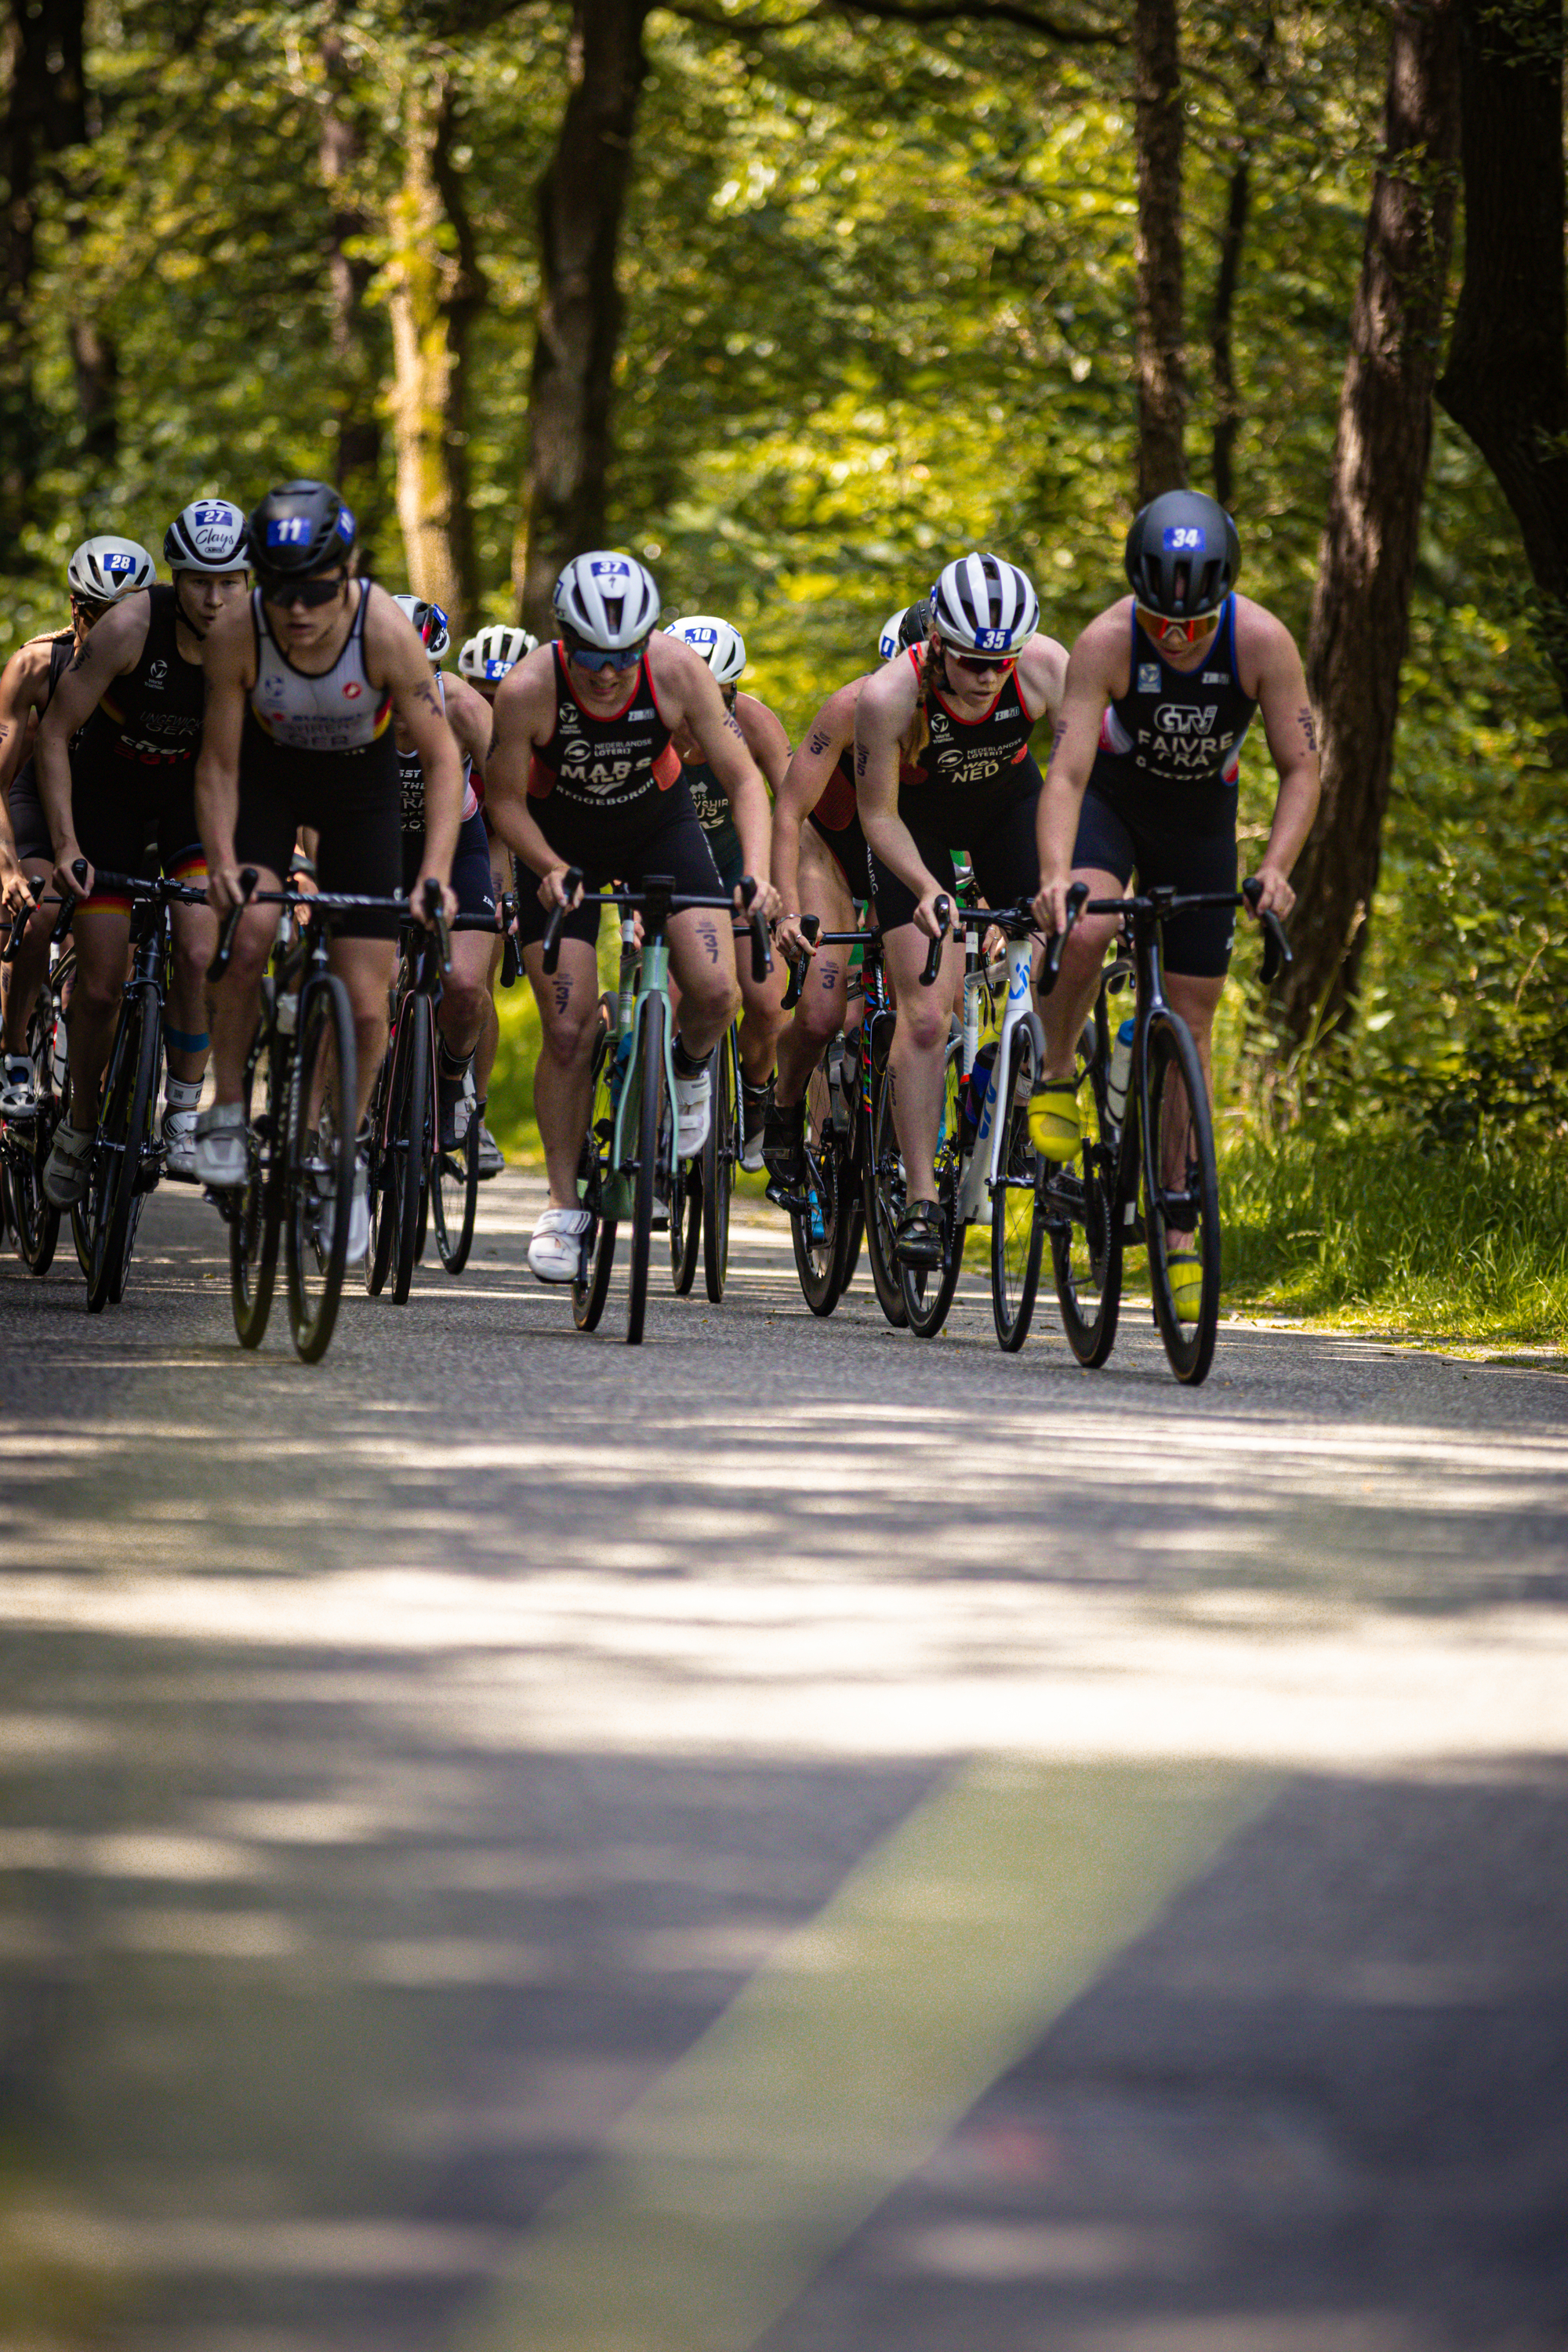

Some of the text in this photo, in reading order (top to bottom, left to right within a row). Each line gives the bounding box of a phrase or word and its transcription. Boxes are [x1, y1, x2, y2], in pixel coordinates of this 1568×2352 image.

[204, 510, 226, 522] 27
[278, 517, 303, 542] 11
[196, 528, 234, 548] Clays
[1172, 528, 1200, 547] 34
[111, 554, 131, 569] 28
[599, 562, 622, 573] 37
[692, 628, 712, 641] 10
[982, 630, 1006, 649] 35
[492, 662, 511, 678] 33
[144, 681, 165, 691] Triathlon
[146, 723, 196, 735] GER
[594, 738, 652, 750] NEDERLANDSE
[932, 736, 955, 745] Triathlon
[967, 738, 1023, 754] NEDERLANDSE
[1138, 728, 1234, 753] FAIVRE
[594, 748, 632, 757] LOTERIJ
[967, 750, 1003, 760] LOTERIJ
[951, 761, 1000, 783] NED
[556, 778, 654, 806] REGGEBORGH
[163, 879, 182, 887] bryton
[702, 934, 719, 964] 37
[822, 974, 837, 989] 3
[555, 986, 569, 1014] 37
